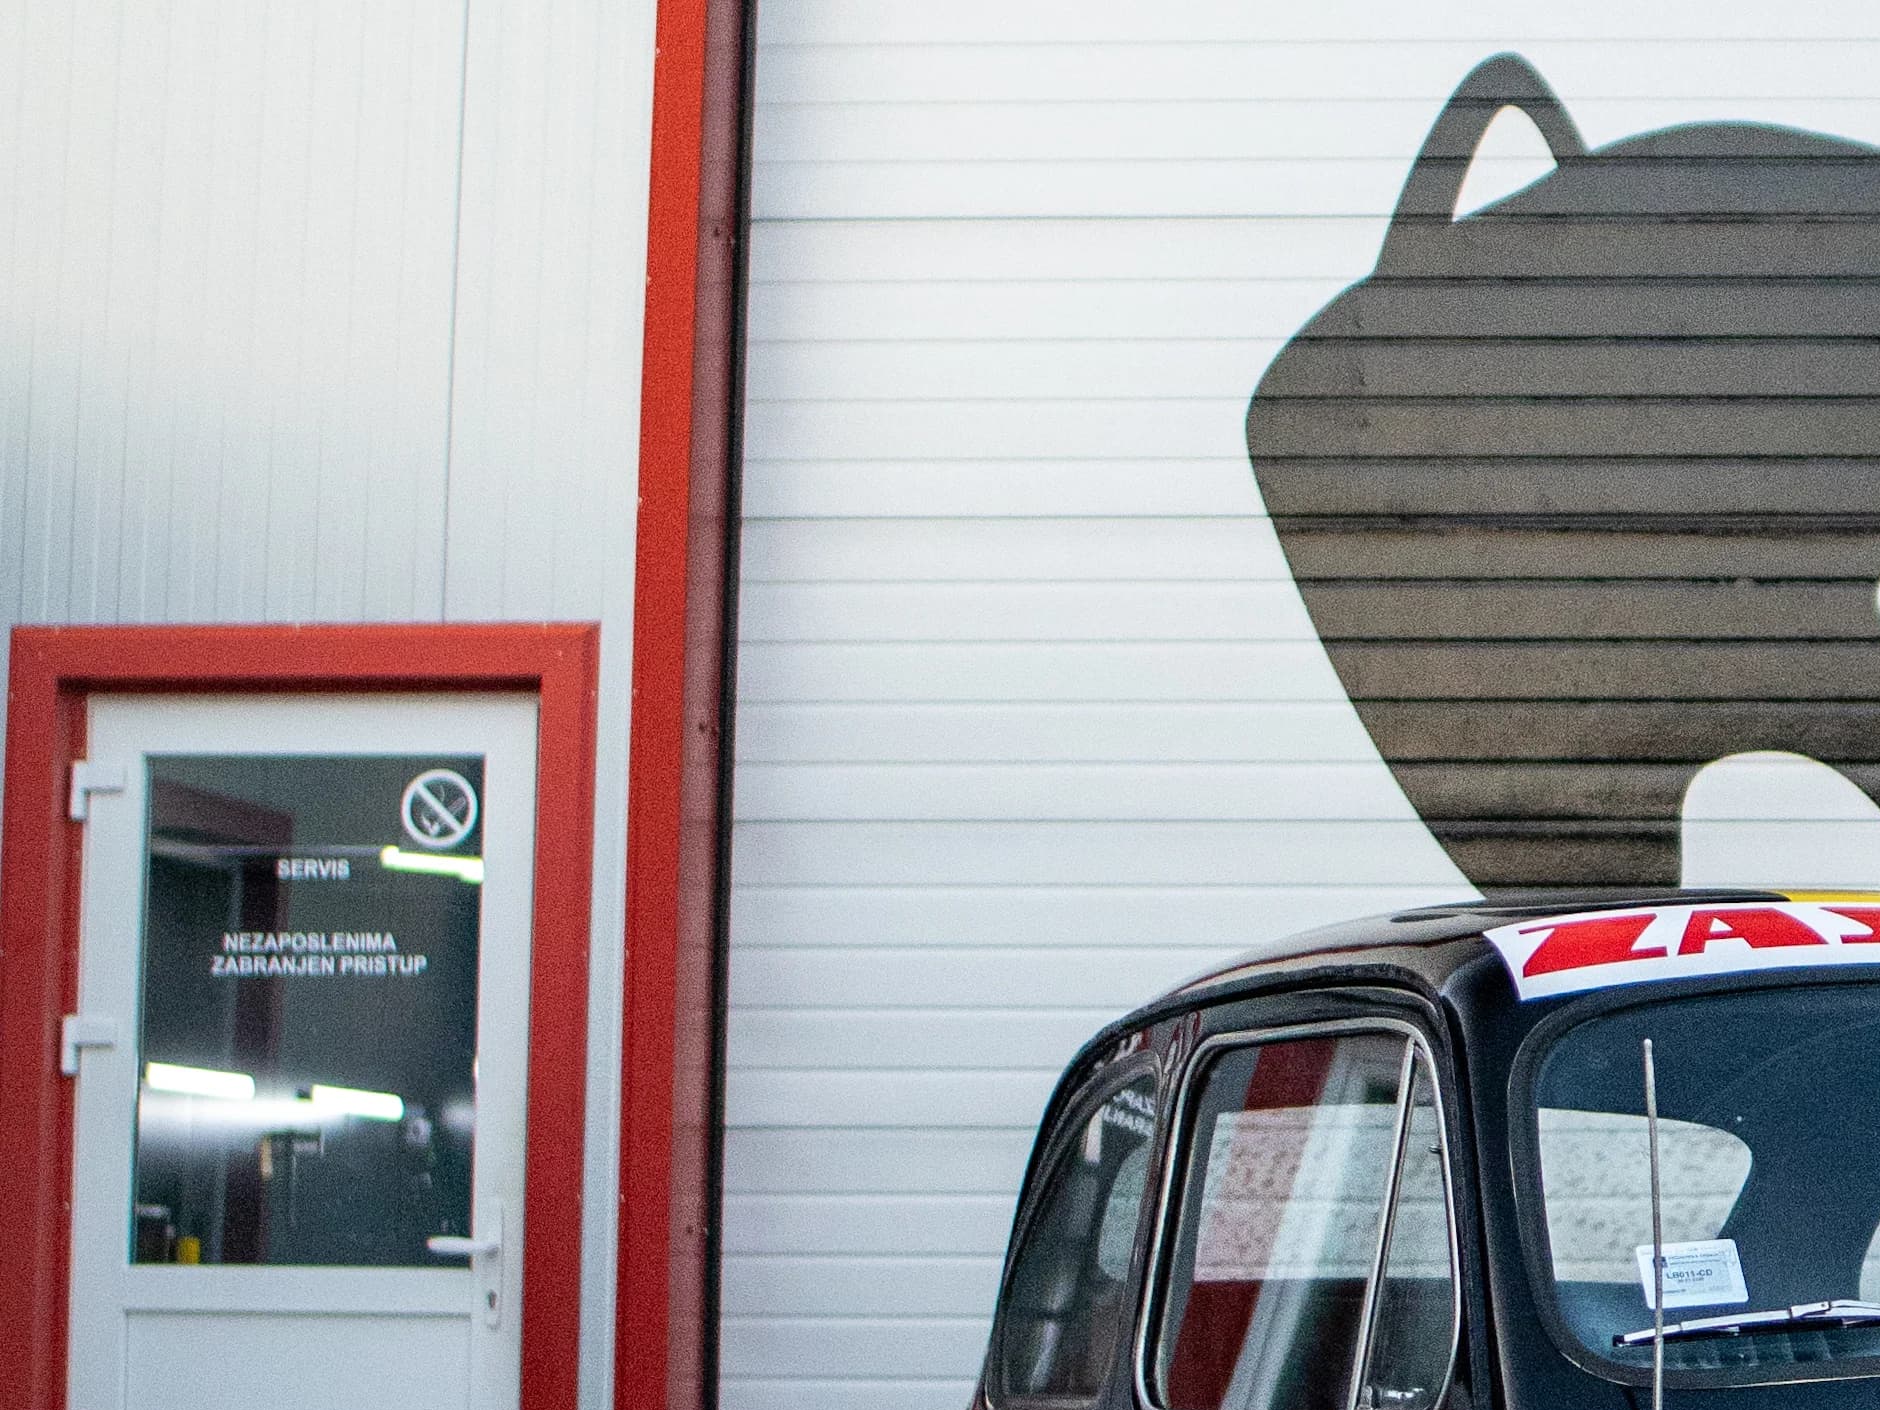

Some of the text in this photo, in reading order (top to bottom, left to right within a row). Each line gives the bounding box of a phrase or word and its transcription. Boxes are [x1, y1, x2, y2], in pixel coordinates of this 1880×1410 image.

[276, 858, 351, 880] SERVIS
[223, 931, 398, 953] NEZAPOSLENIMA
[211, 954, 428, 976] ZABRANJEN PRISTUP
